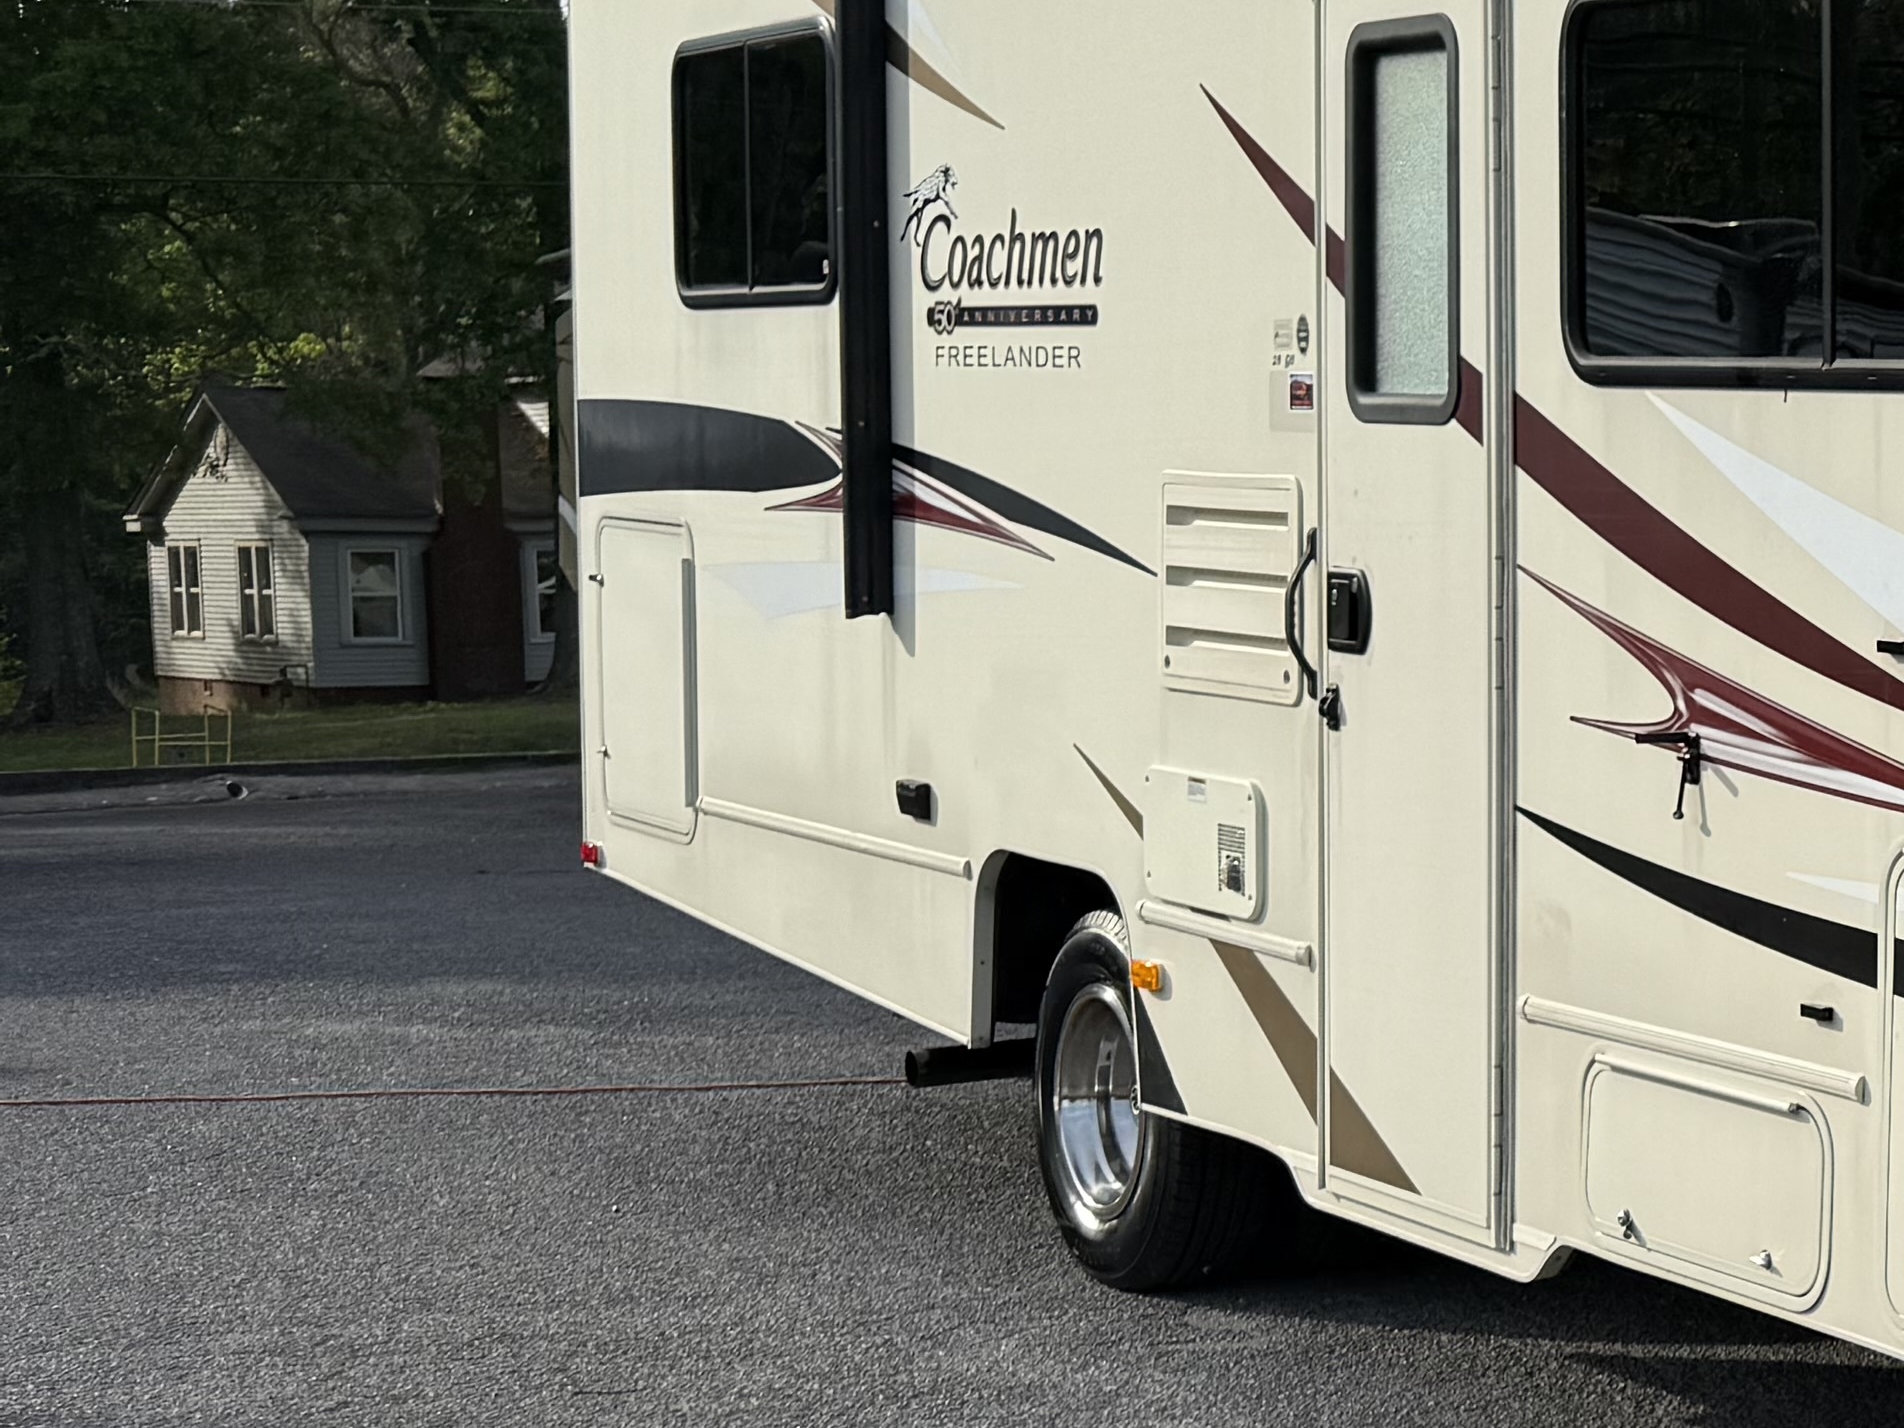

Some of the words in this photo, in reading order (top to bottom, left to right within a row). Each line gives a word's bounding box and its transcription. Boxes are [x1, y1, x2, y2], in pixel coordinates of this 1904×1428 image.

[920, 208, 1103, 292] Coachmen
[962, 308, 1095, 323] ANNIVERSARY
[935, 345, 1082, 369] FREELANDER
